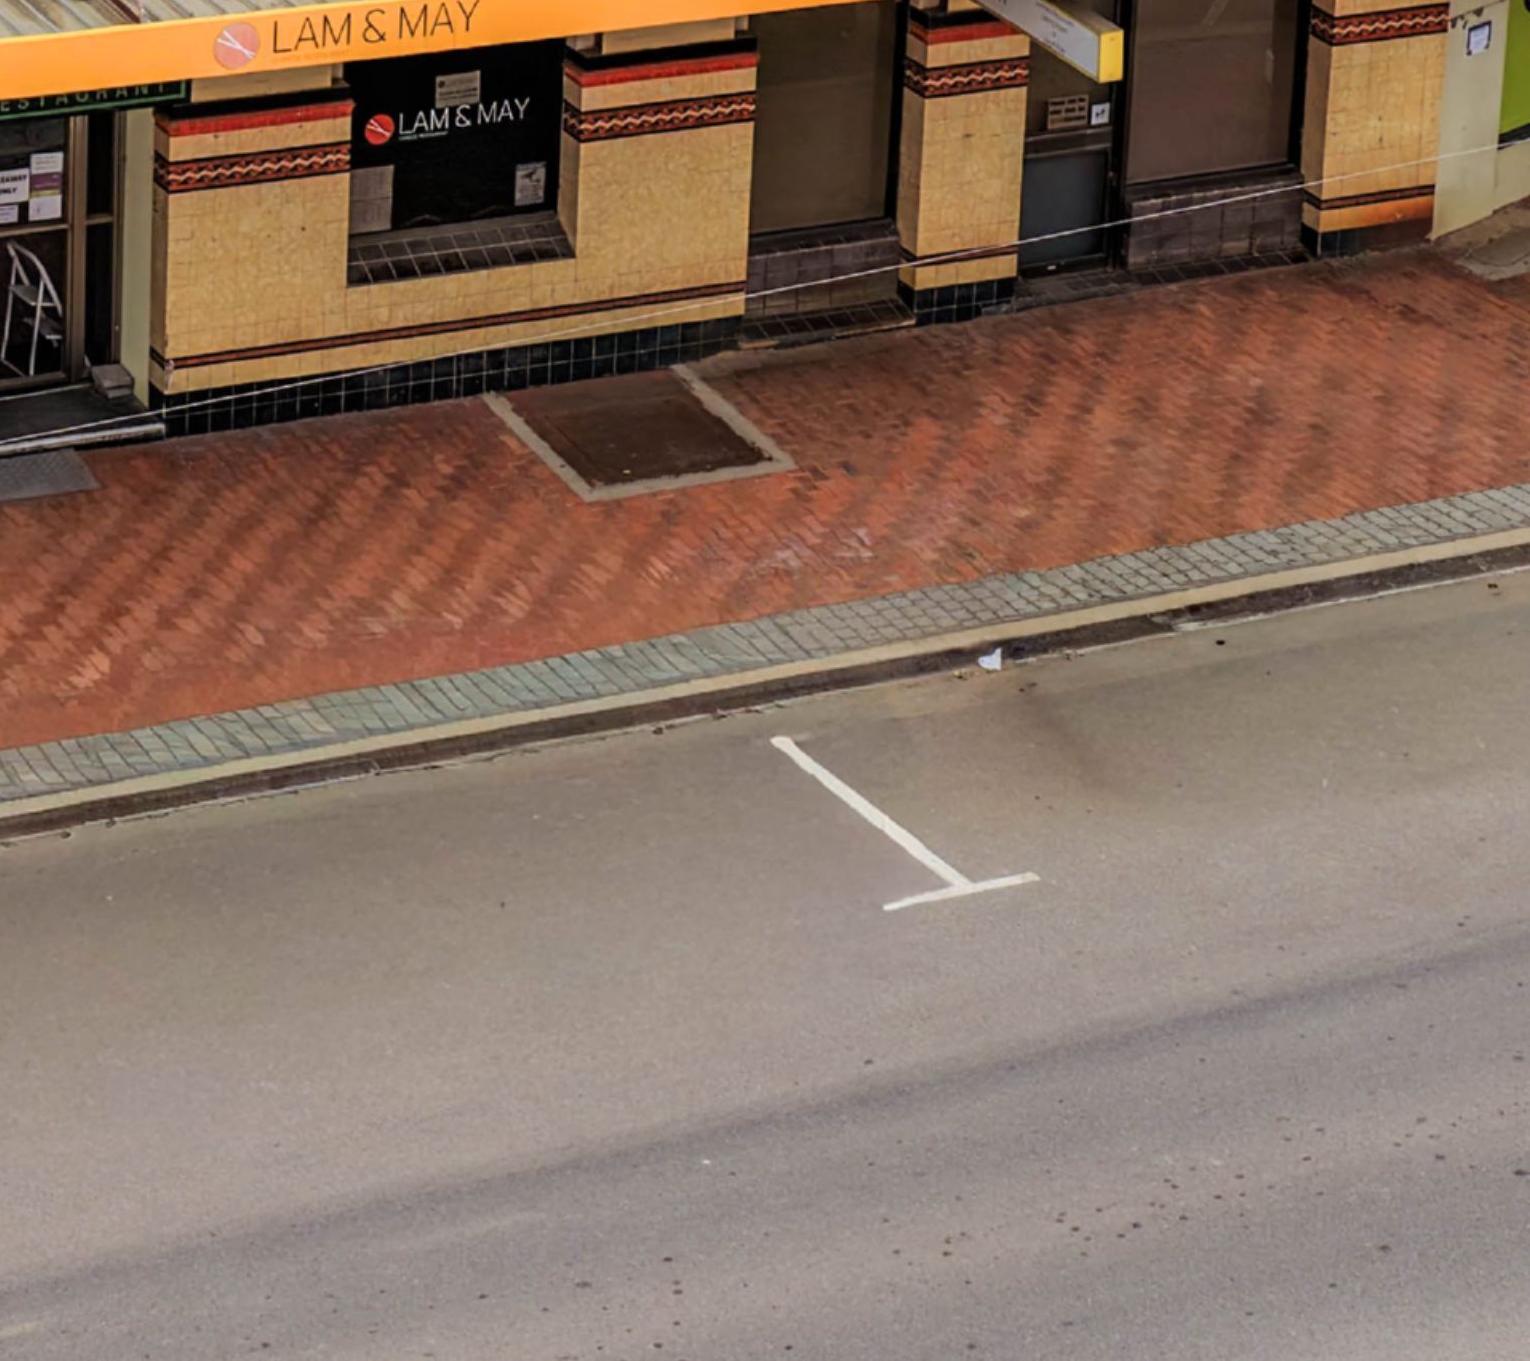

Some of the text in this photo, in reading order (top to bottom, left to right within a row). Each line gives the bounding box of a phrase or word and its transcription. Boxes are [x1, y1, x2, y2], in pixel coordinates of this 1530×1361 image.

[272, 12, 352, 54] LAM
[361, 9, 387, 44] &
[398, 96, 531, 135] LAM & MAY
